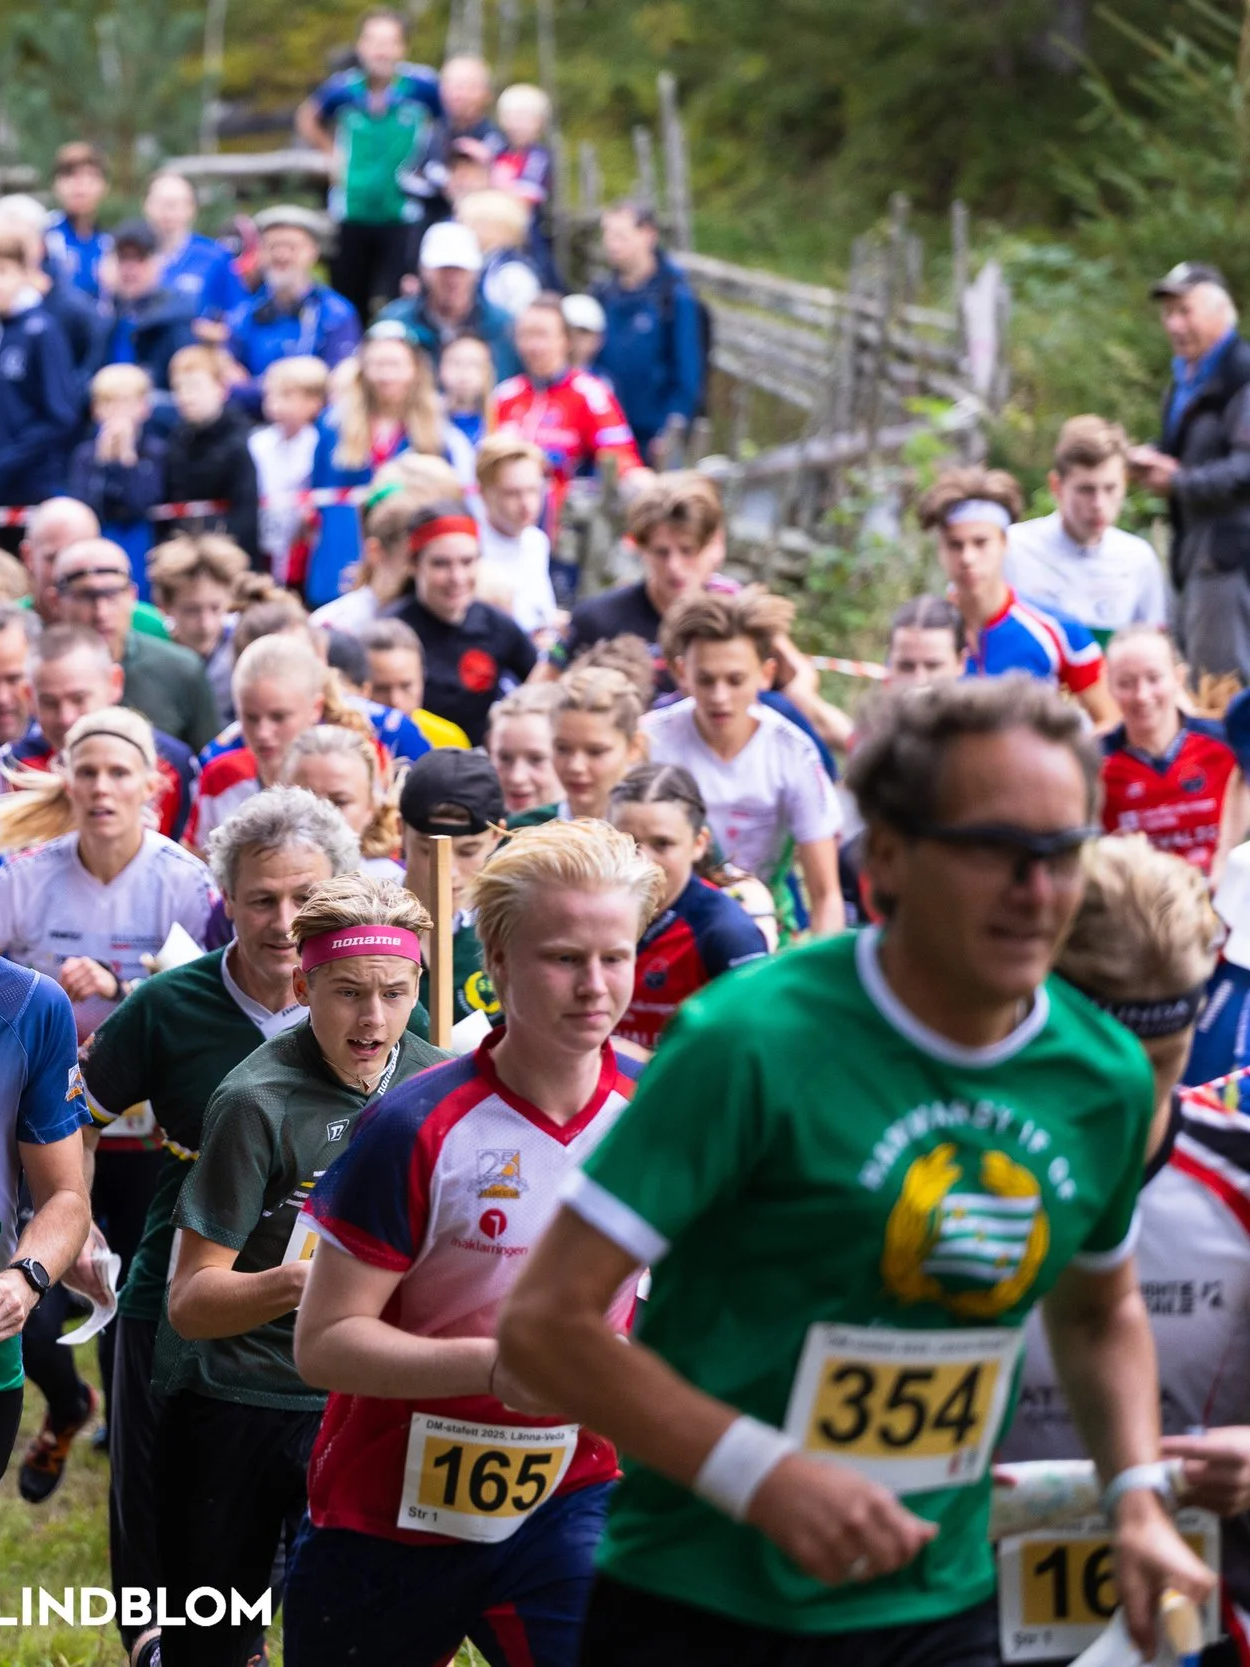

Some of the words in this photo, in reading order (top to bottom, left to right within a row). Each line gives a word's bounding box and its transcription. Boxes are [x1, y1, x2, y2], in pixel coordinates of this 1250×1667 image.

[331, 935, 402, 949] noname
[818, 1360, 983, 1449] 354
[426, 1420, 478, 1437] DM-stafett
[481, 1428, 508, 1440] 2025,
[433, 1446, 553, 1512] 165
[408, 1506, 429, 1520] Str
[432, 1511, 438, 1522] 1
